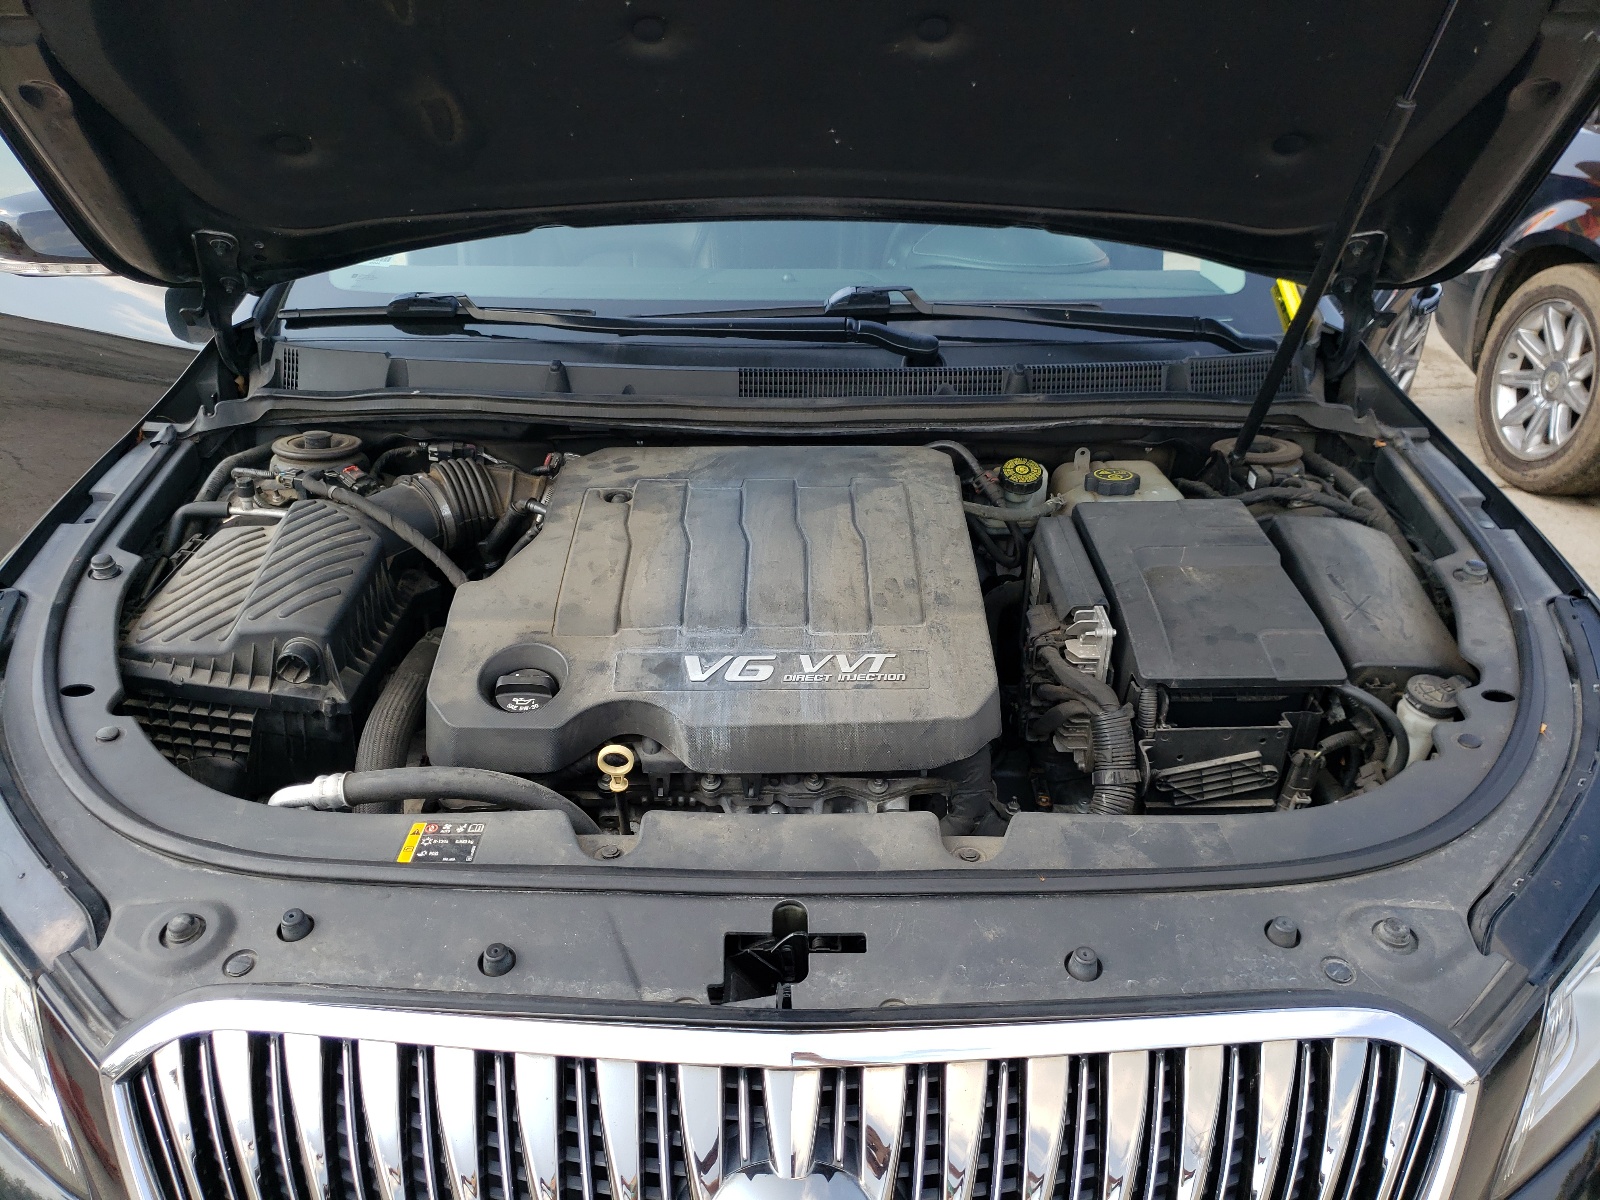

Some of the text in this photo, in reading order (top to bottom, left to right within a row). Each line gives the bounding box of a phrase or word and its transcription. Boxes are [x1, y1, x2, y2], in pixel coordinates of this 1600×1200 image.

[684, 653, 897, 682] V6 VVT
[783, 673, 906, 683] DIRECT INJECTION
